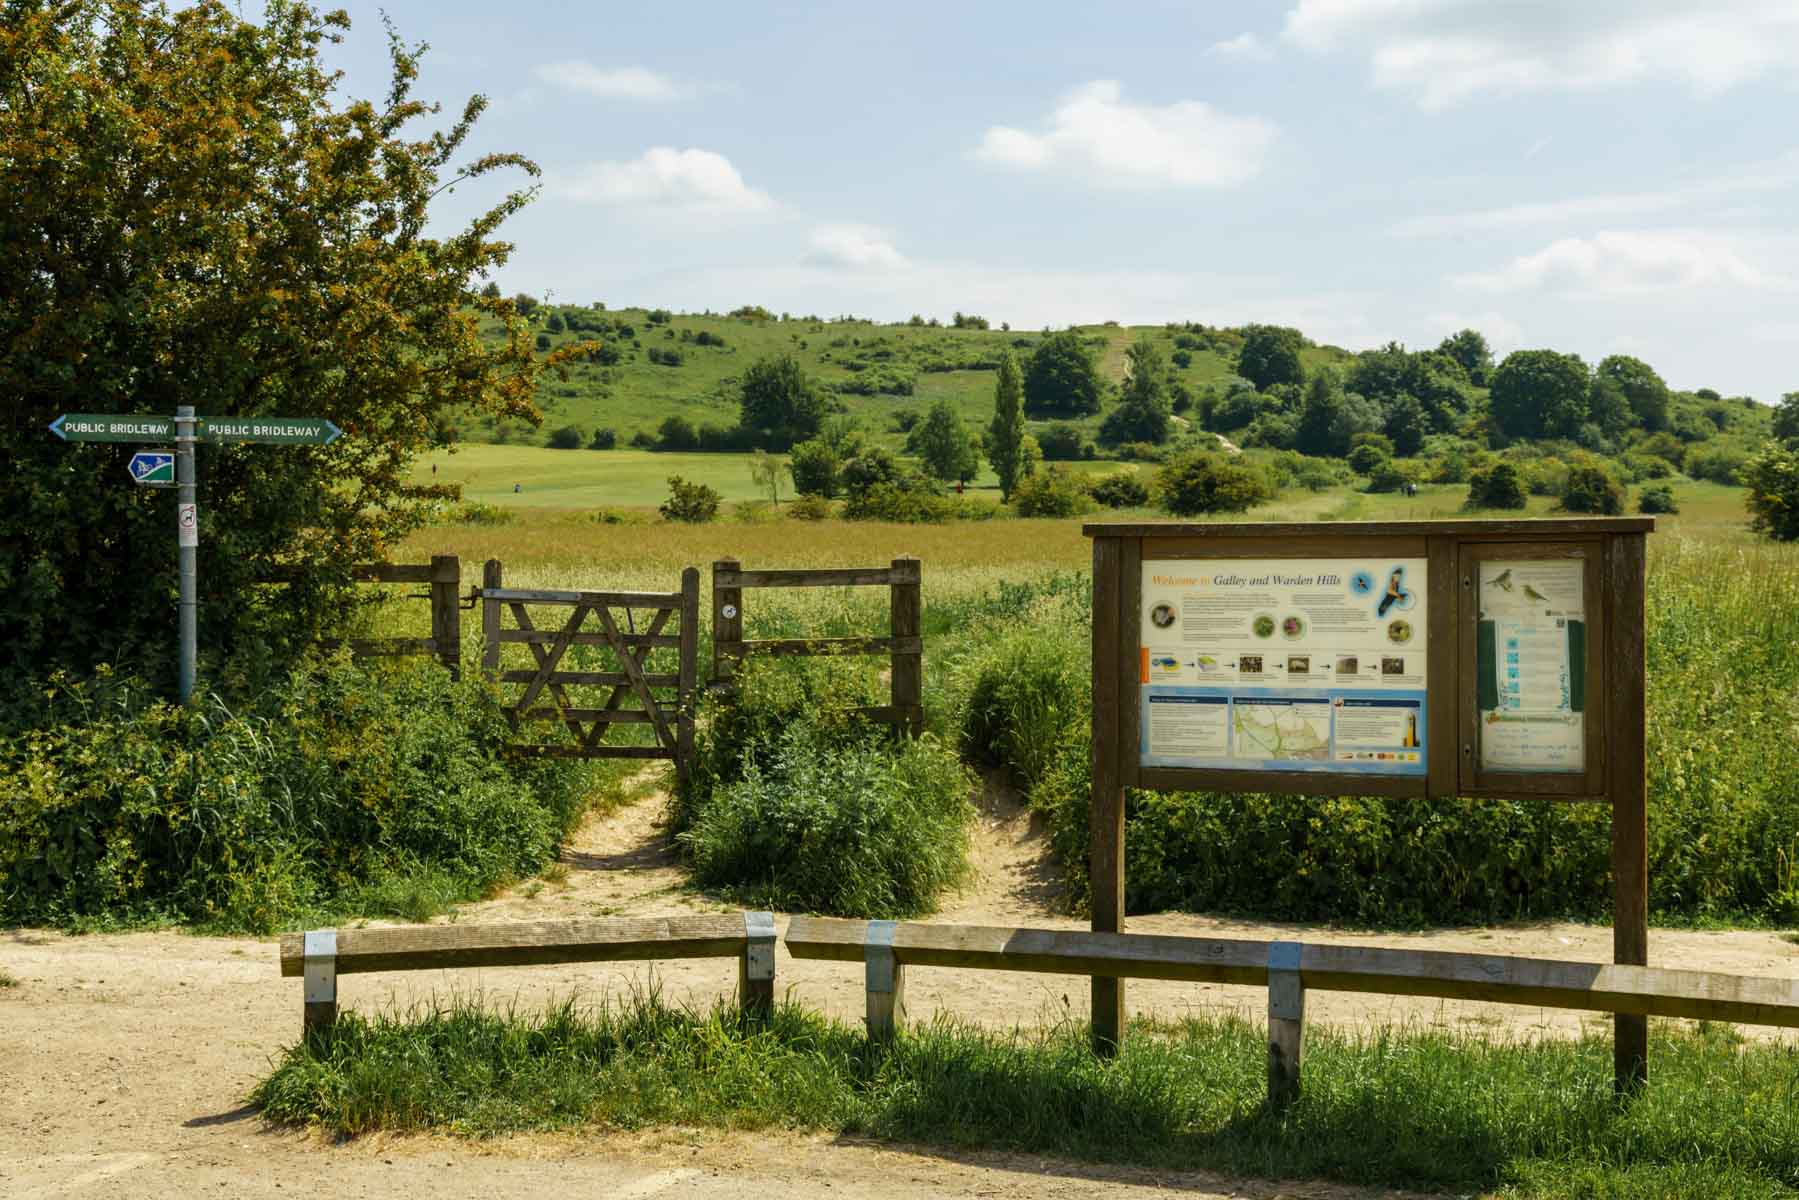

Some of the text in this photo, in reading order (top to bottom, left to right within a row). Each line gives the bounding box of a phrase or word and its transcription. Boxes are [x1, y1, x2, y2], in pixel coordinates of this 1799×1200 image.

[65, 422, 168, 434] PUBLIC BRIDLEWAY
[208, 424, 320, 436] PUBLIC BRIDLEWAY
[1152, 575, 1200, 585] Welcome
[1213, 575, 1247, 588] Galley
[1249, 575, 1270, 585] and
[1272, 575, 1313, 585] Warden
[1316, 575, 1342, 585] Hills
